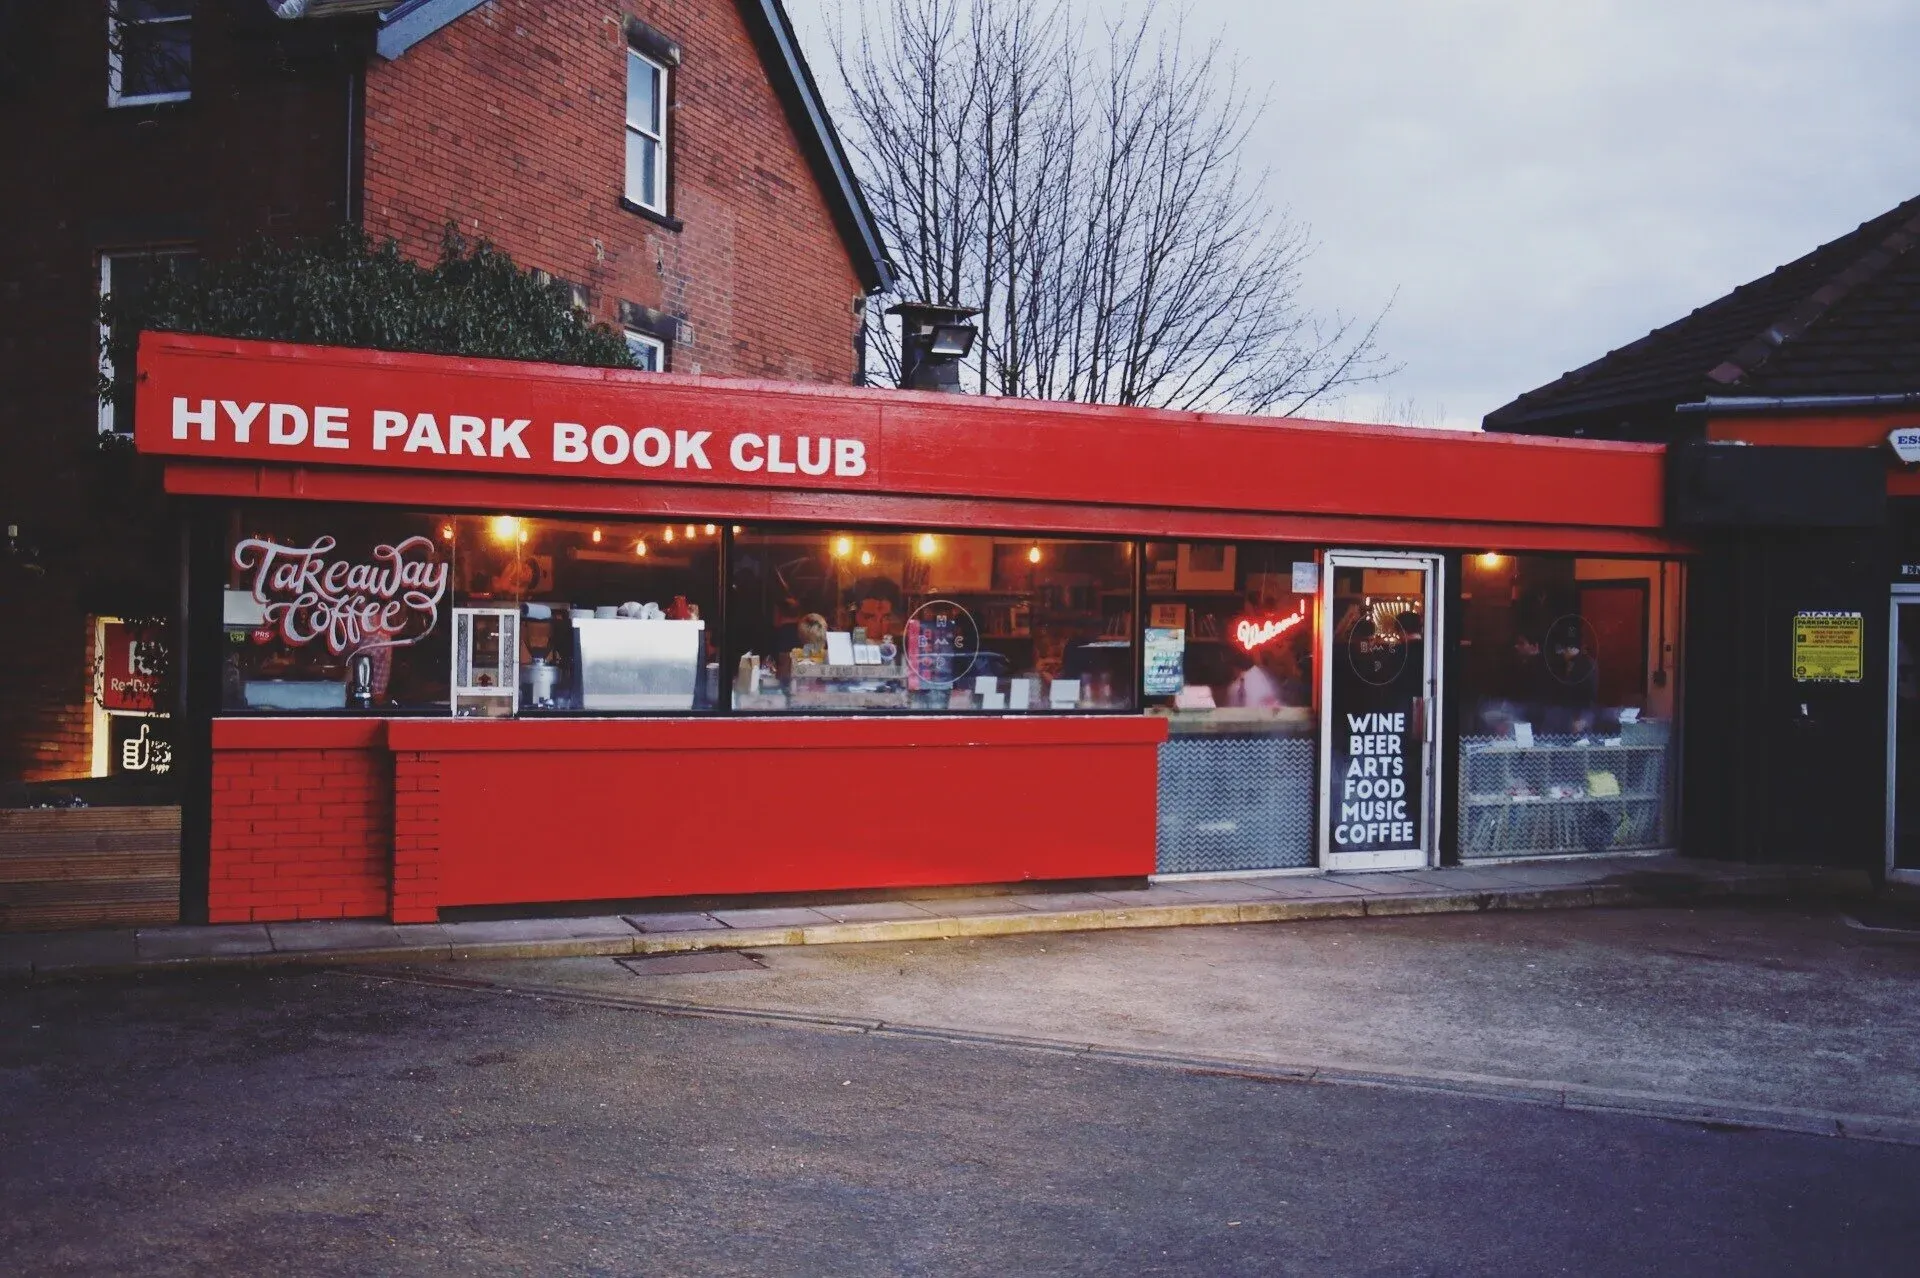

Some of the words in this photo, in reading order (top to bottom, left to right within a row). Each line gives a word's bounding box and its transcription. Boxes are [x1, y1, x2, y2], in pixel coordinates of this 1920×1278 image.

[172, 396, 350, 449] HYDE
[373, 409, 531, 459] PARK
[553, 422, 713, 470] BOOK
[729, 432, 867, 477] CLUB
[234, 535, 449, 645] Takeaway
[263, 592, 409, 652] Coffee
[255, 630, 270, 638] PRS
[1346, 712, 1405, 733] WINE
[1350, 734, 1402, 756] BEER
[1346, 756, 1404, 777] ARTS
[1344, 778, 1405, 800] FOOD
[1341, 800, 1407, 822] MUSIC
[1334, 821, 1414, 845] COFFEE
